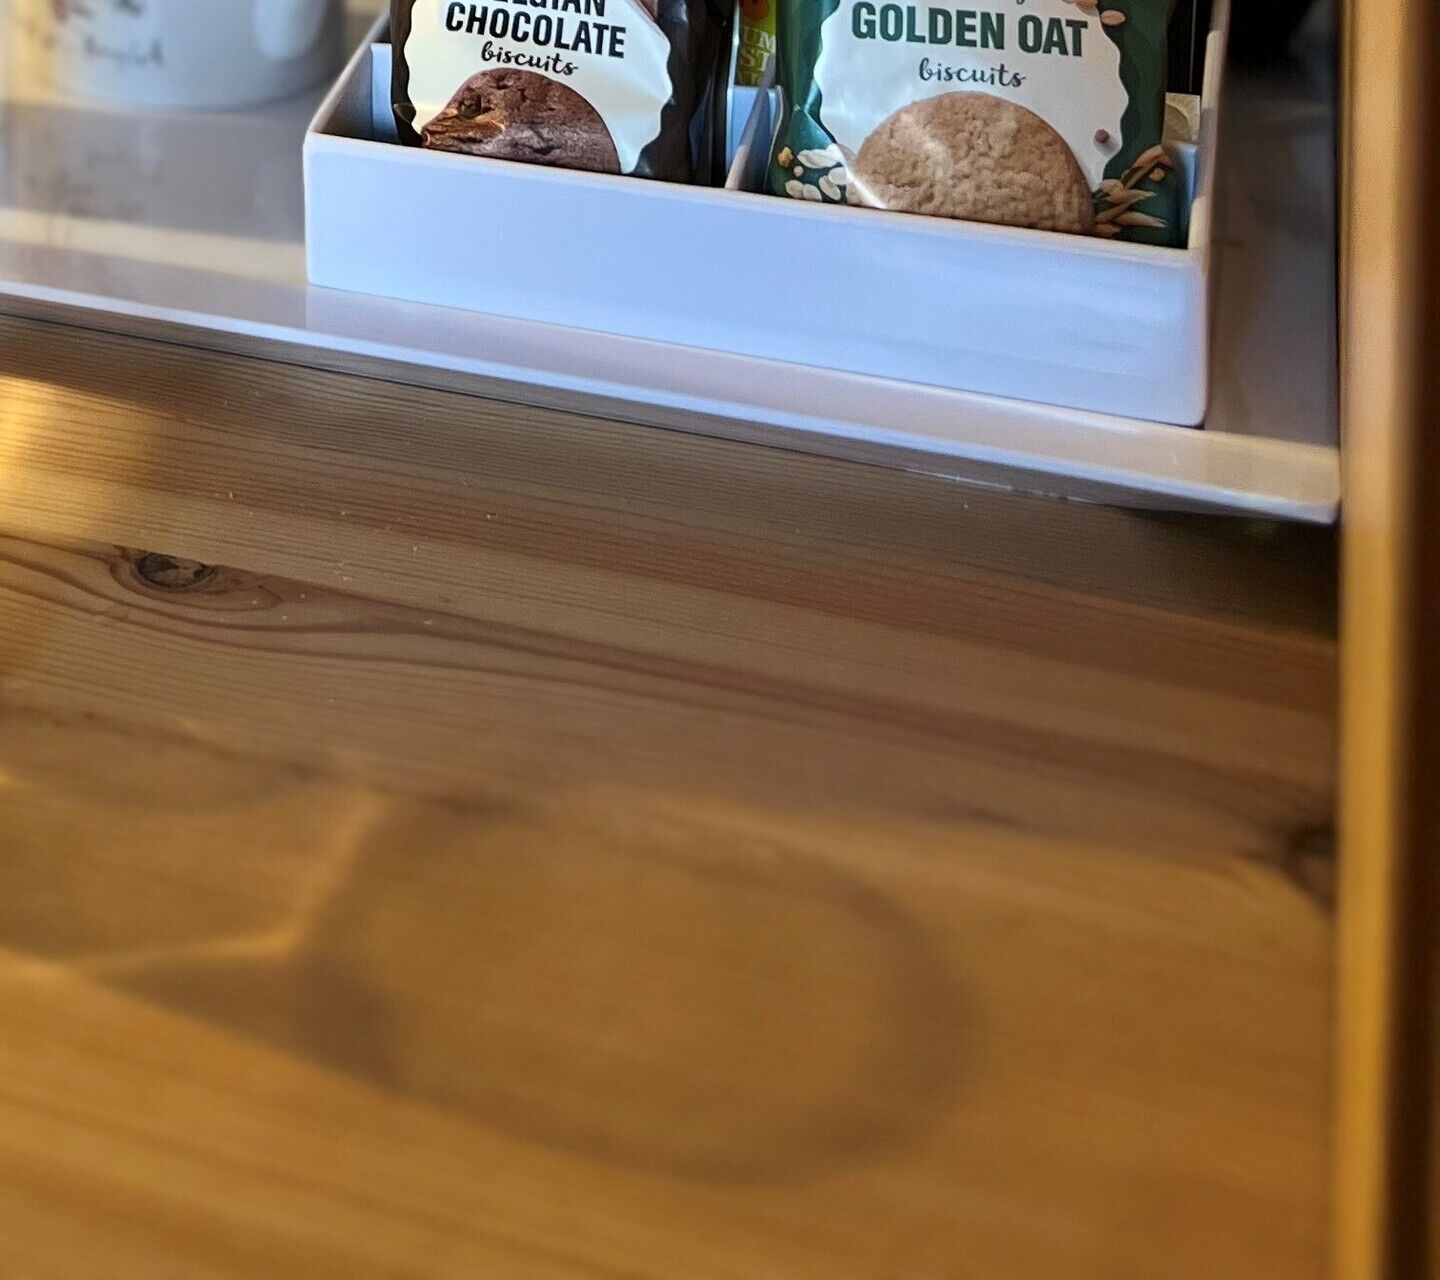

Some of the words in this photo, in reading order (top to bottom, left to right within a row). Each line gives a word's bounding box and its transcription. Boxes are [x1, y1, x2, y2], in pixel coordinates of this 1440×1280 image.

[445, 1, 627, 59] CHOCOLATE
[851, 0, 1006, 51] GOLDEN
[1017, 14, 1089, 57] OAT
[480, 40, 579, 76] biscuits
[918, 56, 1026, 88] biscuits
